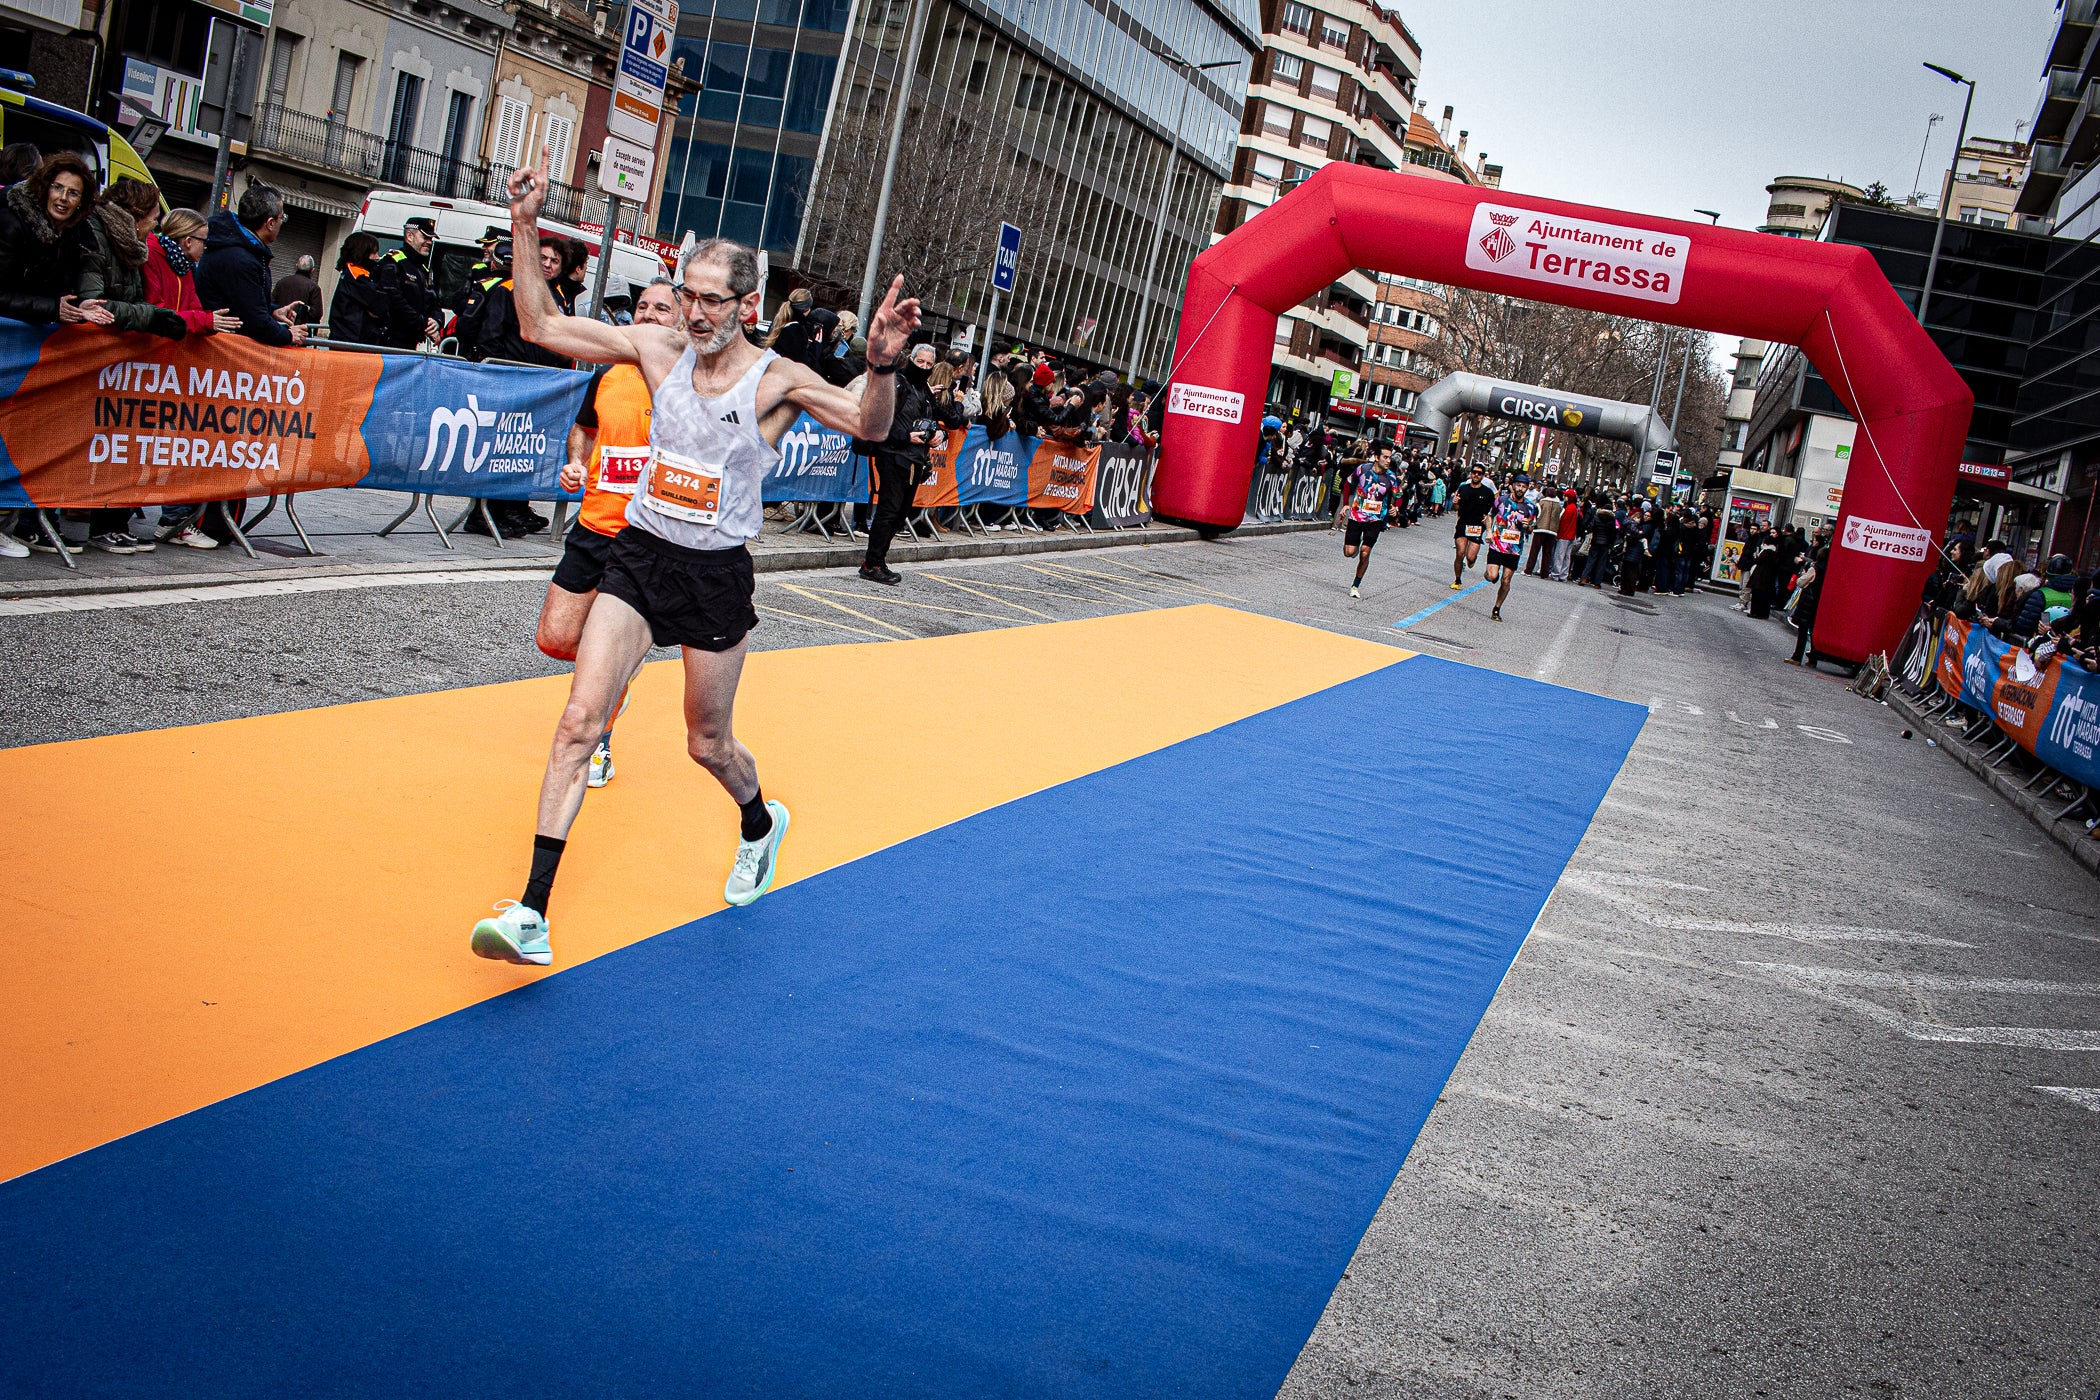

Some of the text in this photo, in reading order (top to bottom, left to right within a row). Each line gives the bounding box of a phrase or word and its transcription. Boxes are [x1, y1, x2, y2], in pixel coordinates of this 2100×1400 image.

[632, 12, 648, 46] P
[127, 67, 155, 84] Videojocs
[616, 149, 646, 167] Excepte serveis
[613, 160, 645, 177] de manteniment
[625, 182, 635, 191] FGC
[580, 223, 605, 232] HOUS
[637, 238, 660, 253] OUSE
[660, 246, 669, 255] of
[1528, 219, 1677, 258] Ajuntament de
[1000, 246, 1017, 269] TAXI
[1525, 242, 1670, 293] Terrassa
[99, 361, 305, 406] MITJA MARATÓ
[1183, 388, 1227, 402] Ajuntament
[1183, 398, 1239, 418] Terrassa
[1500, 396, 1559, 424] CIRSA
[94, 396, 317, 439] INTERNACIONAL
[496, 412, 534, 433] MITJA
[492, 428, 547, 455] MARATÓ
[820, 433, 847, 450] MITJA
[89, 433, 281, 471] DE TERRASSA
[998, 450, 1014, 465] MITJA
[1052, 454, 1069, 468] MITJA
[488, 458, 534, 473] TERRASSA
[615, 459, 643, 471] 113
[808, 465, 838, 477] TERRASSA
[995, 464, 1018, 480] MARATÓ
[1967, 465, 1973, 473] 6
[1975, 466, 1981, 474] 9
[1982, 467, 1990, 476] 12
[1990, 468, 1998, 477] 13
[665, 470, 700, 491] 2474
[993, 479, 1011, 489] TERRASSA
[1099, 456, 1143, 519] CIRSA
[661, 489, 699, 505] GUILLERMO
[1043, 483, 1079, 499] DE TERRASSA
[1863, 524, 1927, 542] Ajuntament de
[1862, 534, 1924, 557] Terrassa
[2080, 700, 2099, 723] MITJA
[2072, 740, 2093, 760] TERRASSA
